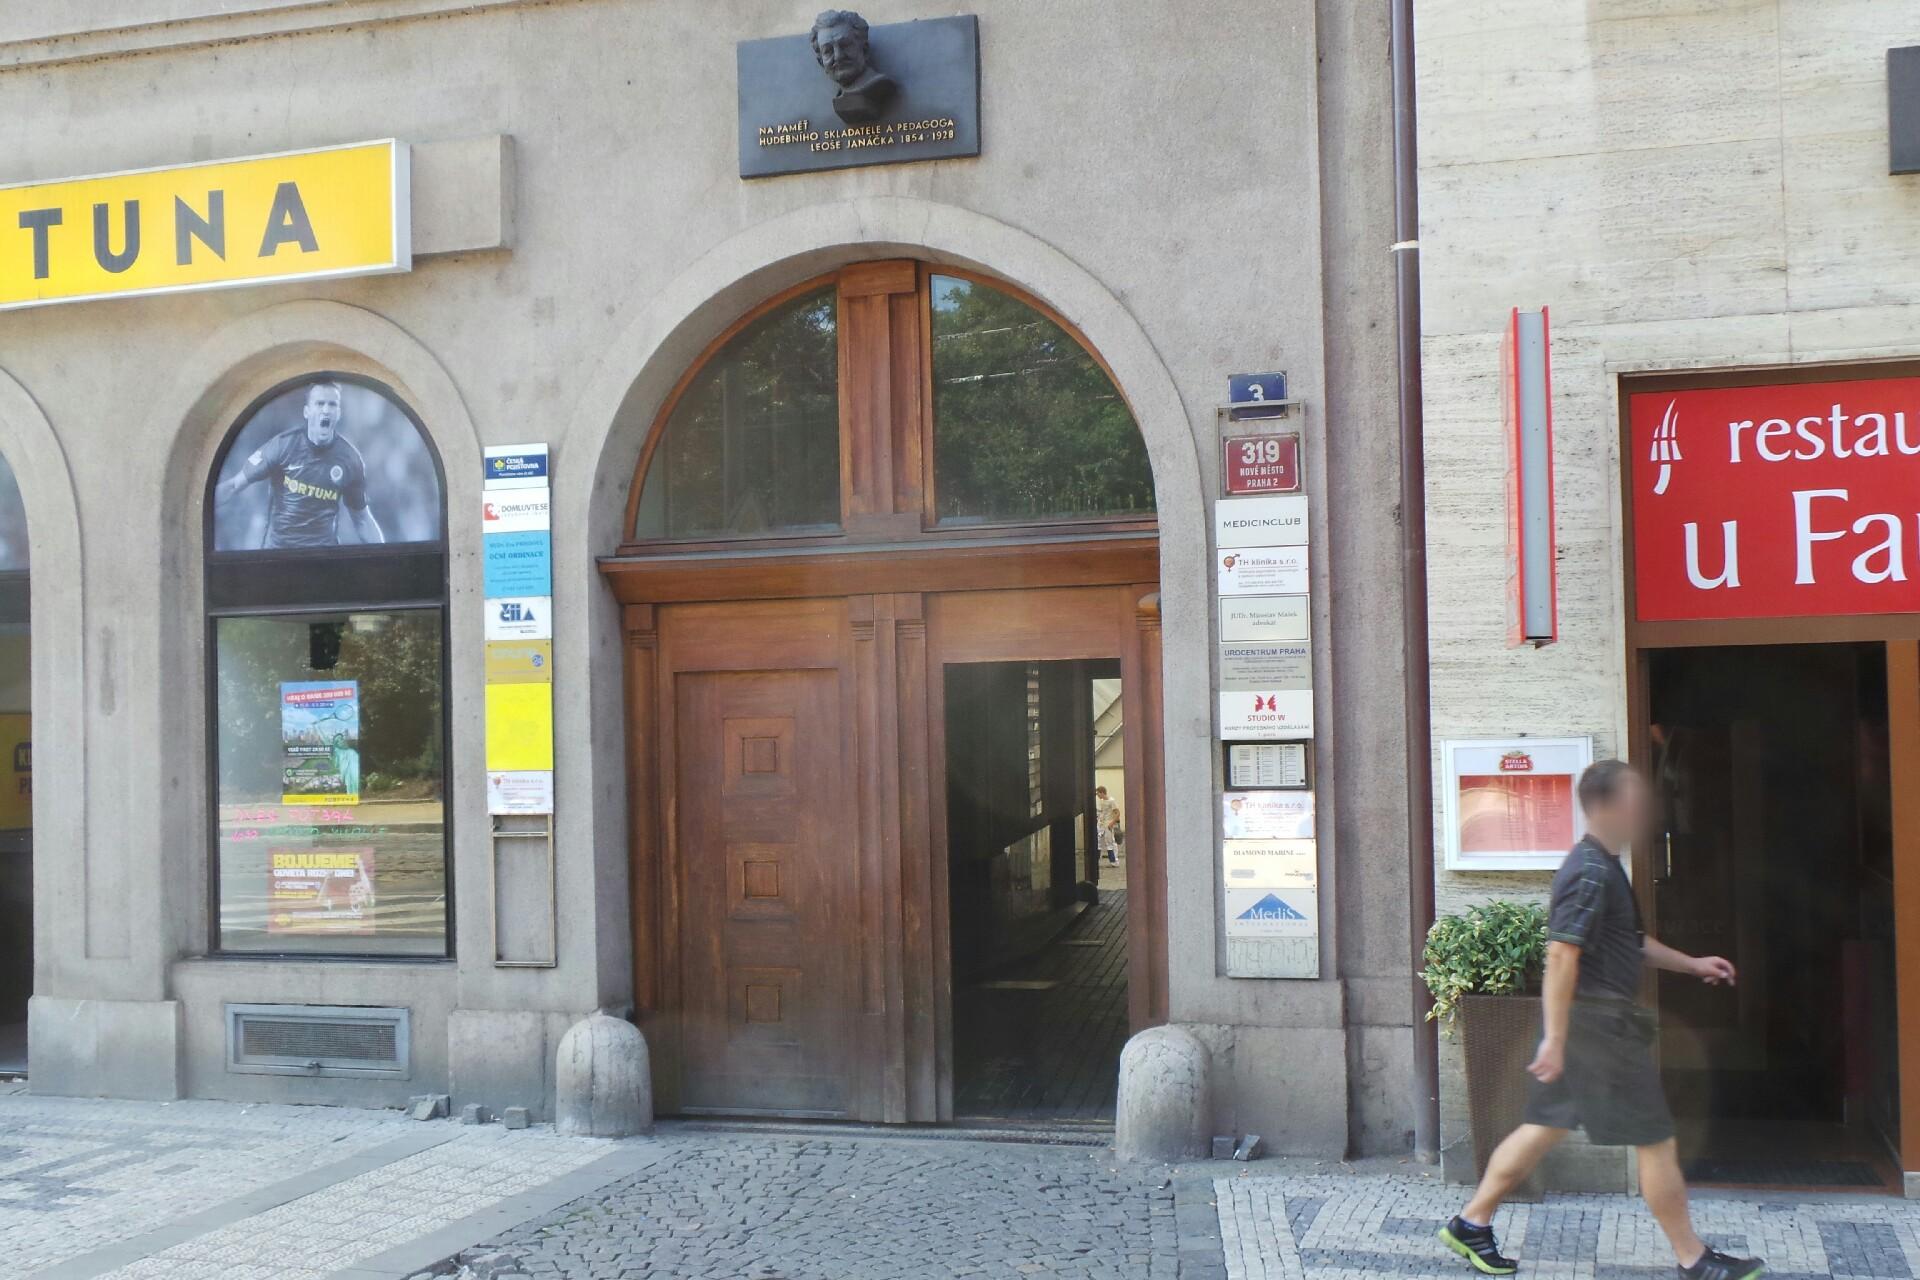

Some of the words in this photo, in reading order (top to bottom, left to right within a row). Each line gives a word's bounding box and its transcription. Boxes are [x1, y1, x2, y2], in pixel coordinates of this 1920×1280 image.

[759, 126, 774, 136] NA
[777, 119, 809, 134] PAMĚŤ
[759, 130, 819, 146] HUDEBNÍHO
[824, 125, 881, 139] SKLADATELE
[886, 124, 894, 133] A
[897, 118, 954, 132] PEDAGOGA
[846, 134, 895, 149] JANÁČKA
[900, 133, 924, 143] 1854
[931, 129, 954, 141] 1928
[18, 181, 319, 279] TUNA
[1248, 383, 1264, 402] 3
[1241, 440, 1280, 464] 319
[1240, 465, 1259, 476] NOVÉ
[1247, 478, 1271, 488] PRAHA
[1273, 478, 1278, 487] 2
[1223, 517, 1301, 528] MEDICINCLUB
[1683, 520, 1741, 590] u
[1791, 488, 1920, 585] Fa
[508, 550, 544, 559] ORDINACE
[1251, 558, 1277, 566] klinika
[1224, 648, 1277, 657] UROCENTRUM
[1247, 714, 1276, 722] STUDIO
[1250, 907, 1295, 920] MediS
